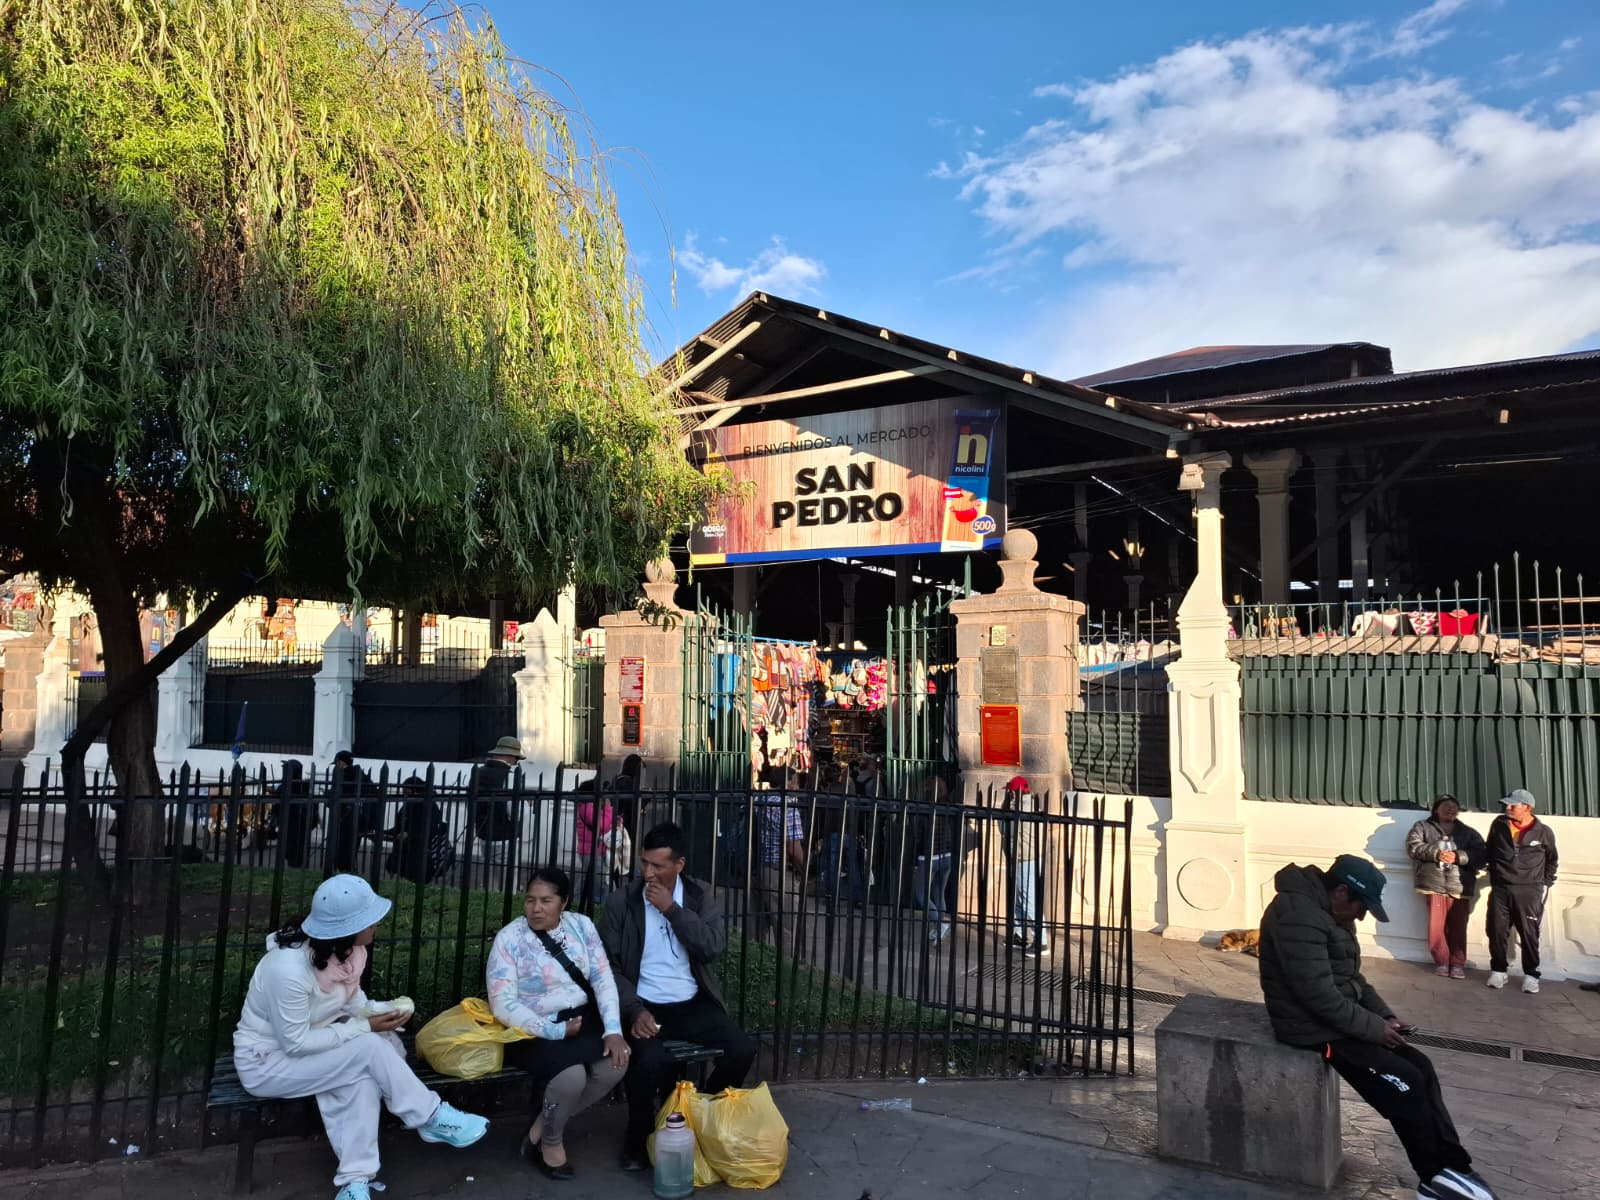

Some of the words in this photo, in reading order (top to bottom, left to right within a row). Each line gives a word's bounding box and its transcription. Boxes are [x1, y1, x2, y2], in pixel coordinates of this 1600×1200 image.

[743, 436, 832, 456] BIENVENIDOS
[835, 434, 854, 447] AL
[857, 425, 930, 444] MERCADO
[795, 461, 876, 495] SAN
[955, 465, 984, 473] nicolini
[772, 492, 904, 529] PEDRO
